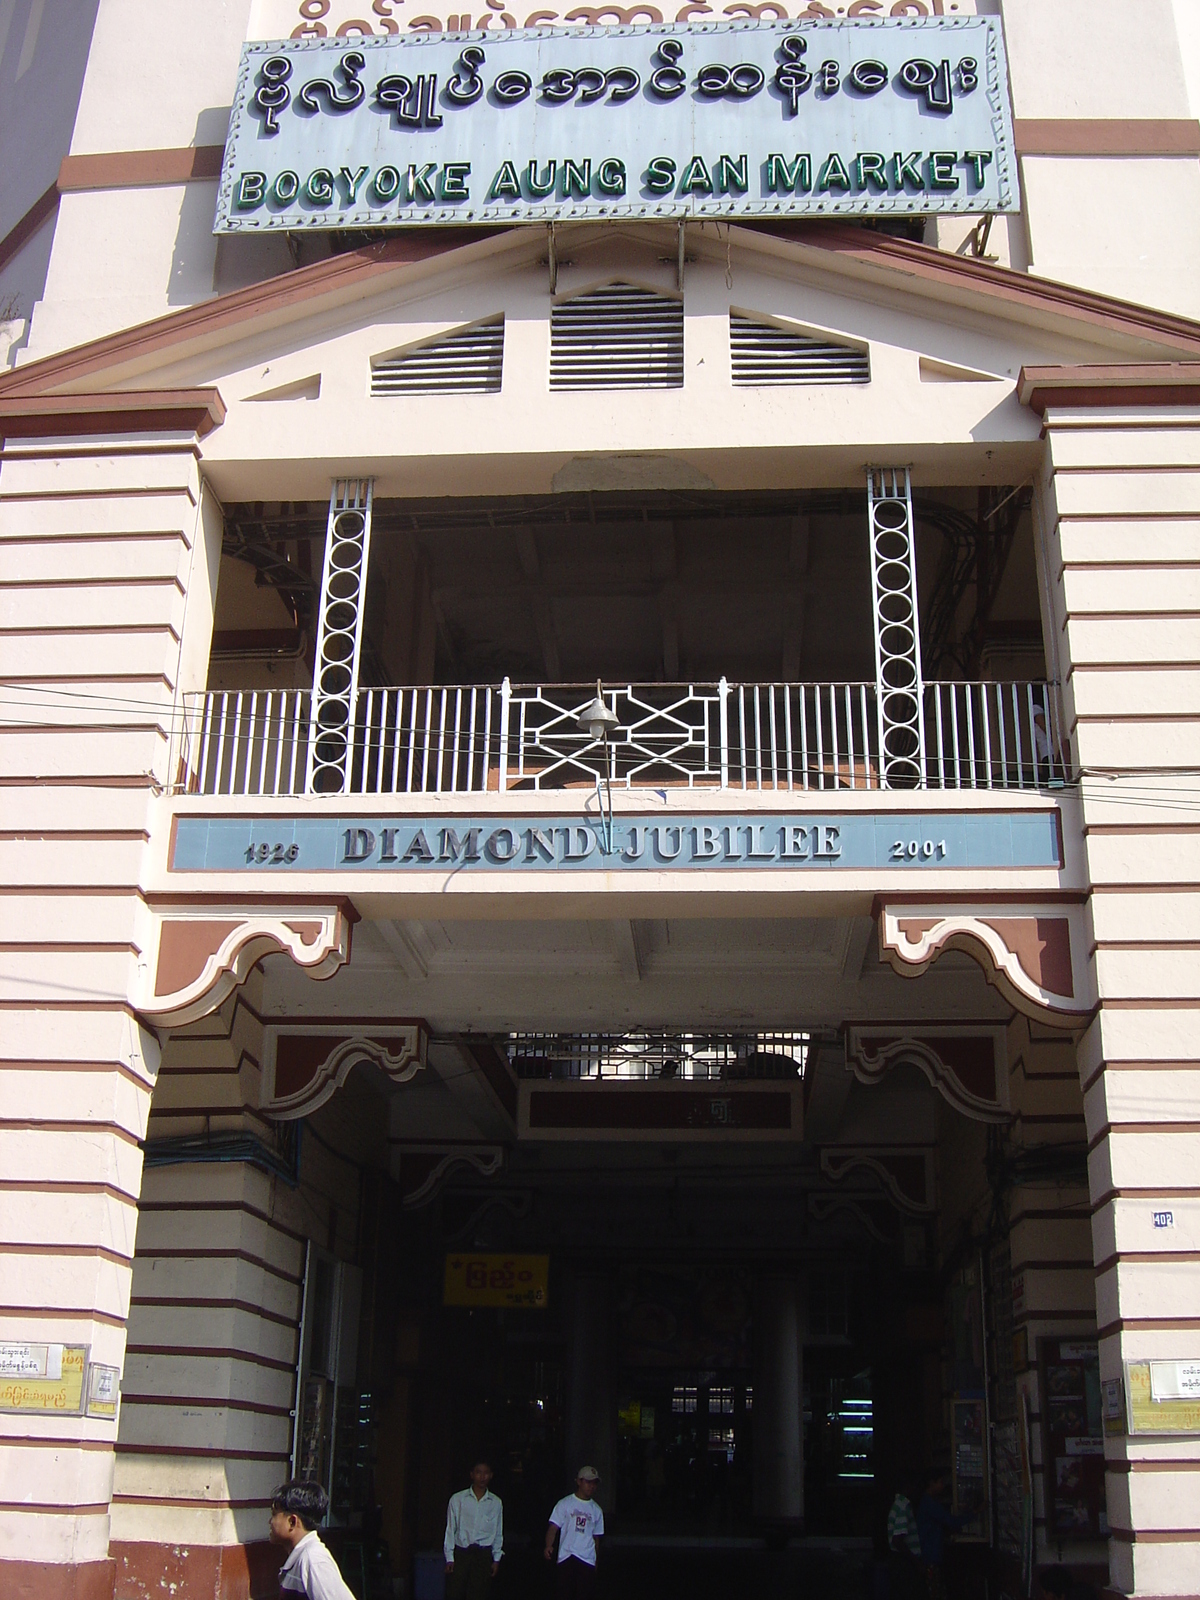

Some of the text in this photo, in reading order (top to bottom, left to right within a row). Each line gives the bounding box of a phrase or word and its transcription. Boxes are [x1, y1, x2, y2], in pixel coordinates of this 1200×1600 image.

[237, 151, 993, 209] BOGYOKE AUNG SAN MARKET
[247, 824, 948, 863] 1926 DIAMOND JUBILEE 2001
